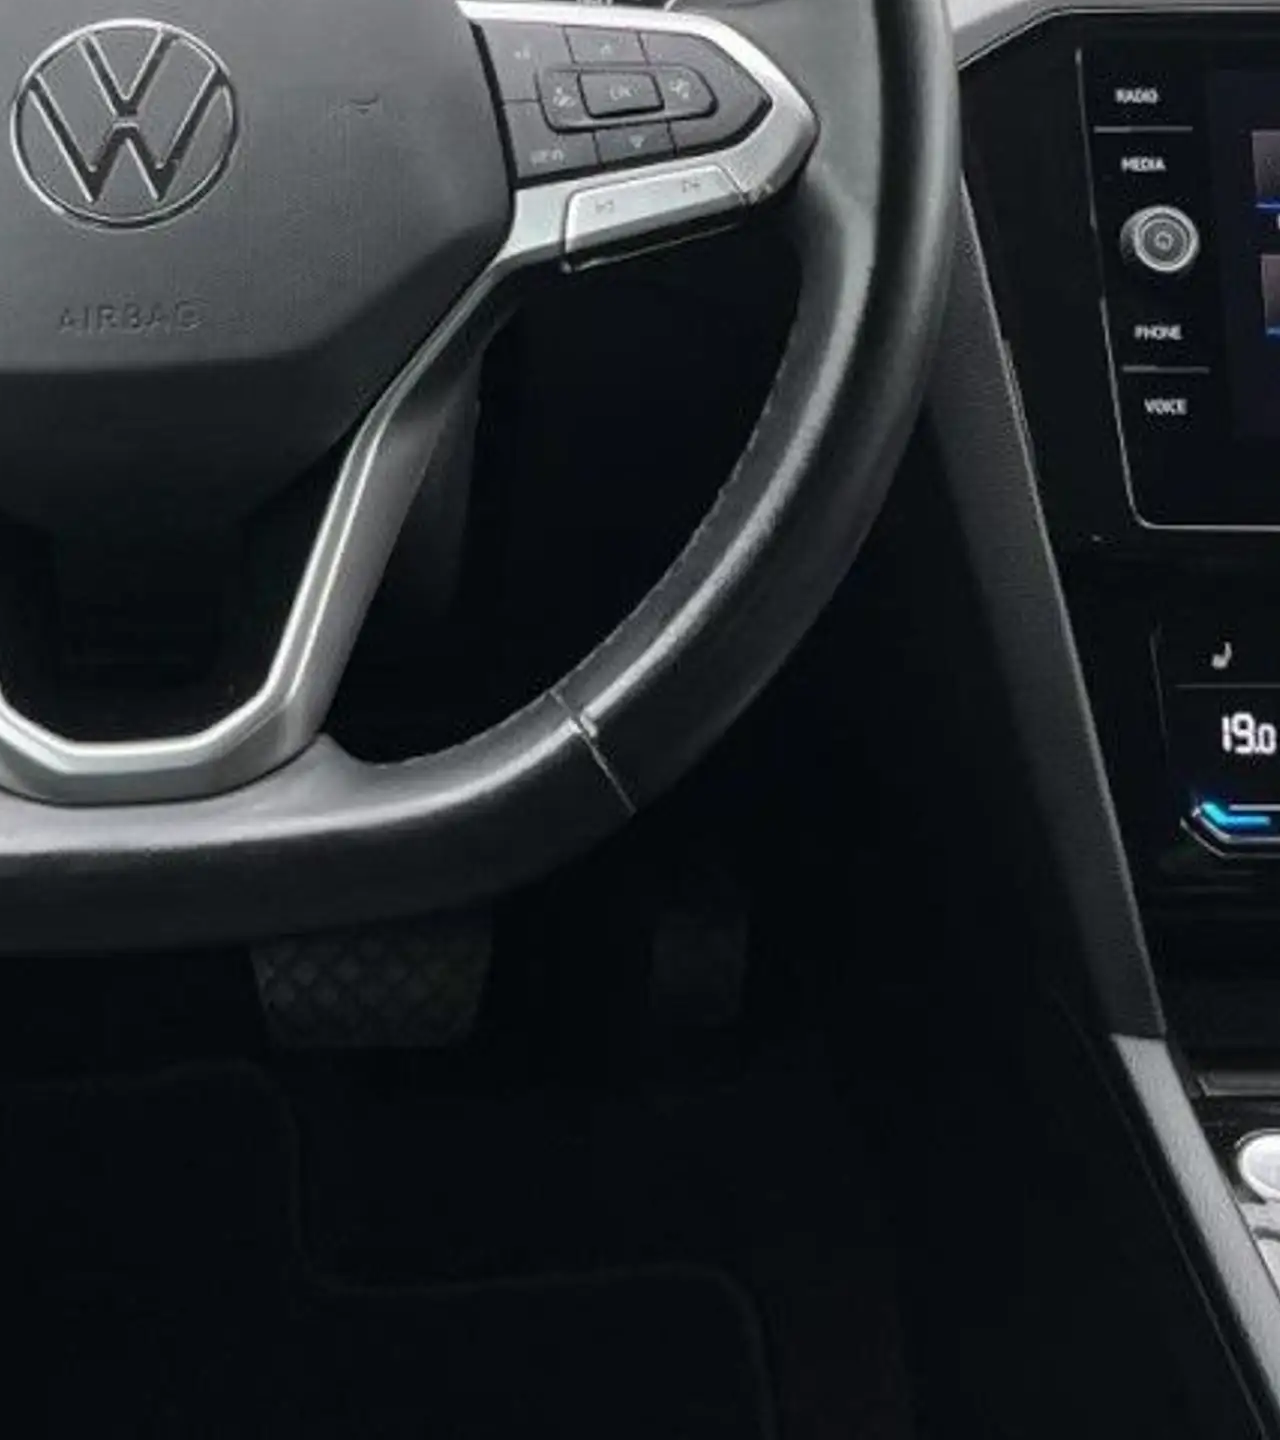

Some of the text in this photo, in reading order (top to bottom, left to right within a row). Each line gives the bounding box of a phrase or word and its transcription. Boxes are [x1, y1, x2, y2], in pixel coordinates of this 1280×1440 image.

[1116, 88, 1158, 103] RADIO
[18, 24, 230, 216] VW
[1122, 157, 1165, 171] MEDIA
[60, 301, 202, 333] AIRBAG
[1135, 326, 1181, 340] PHONE
[1145, 399, 1185, 414] VOICE
[1222, 713, 1276, 754] 19.0
